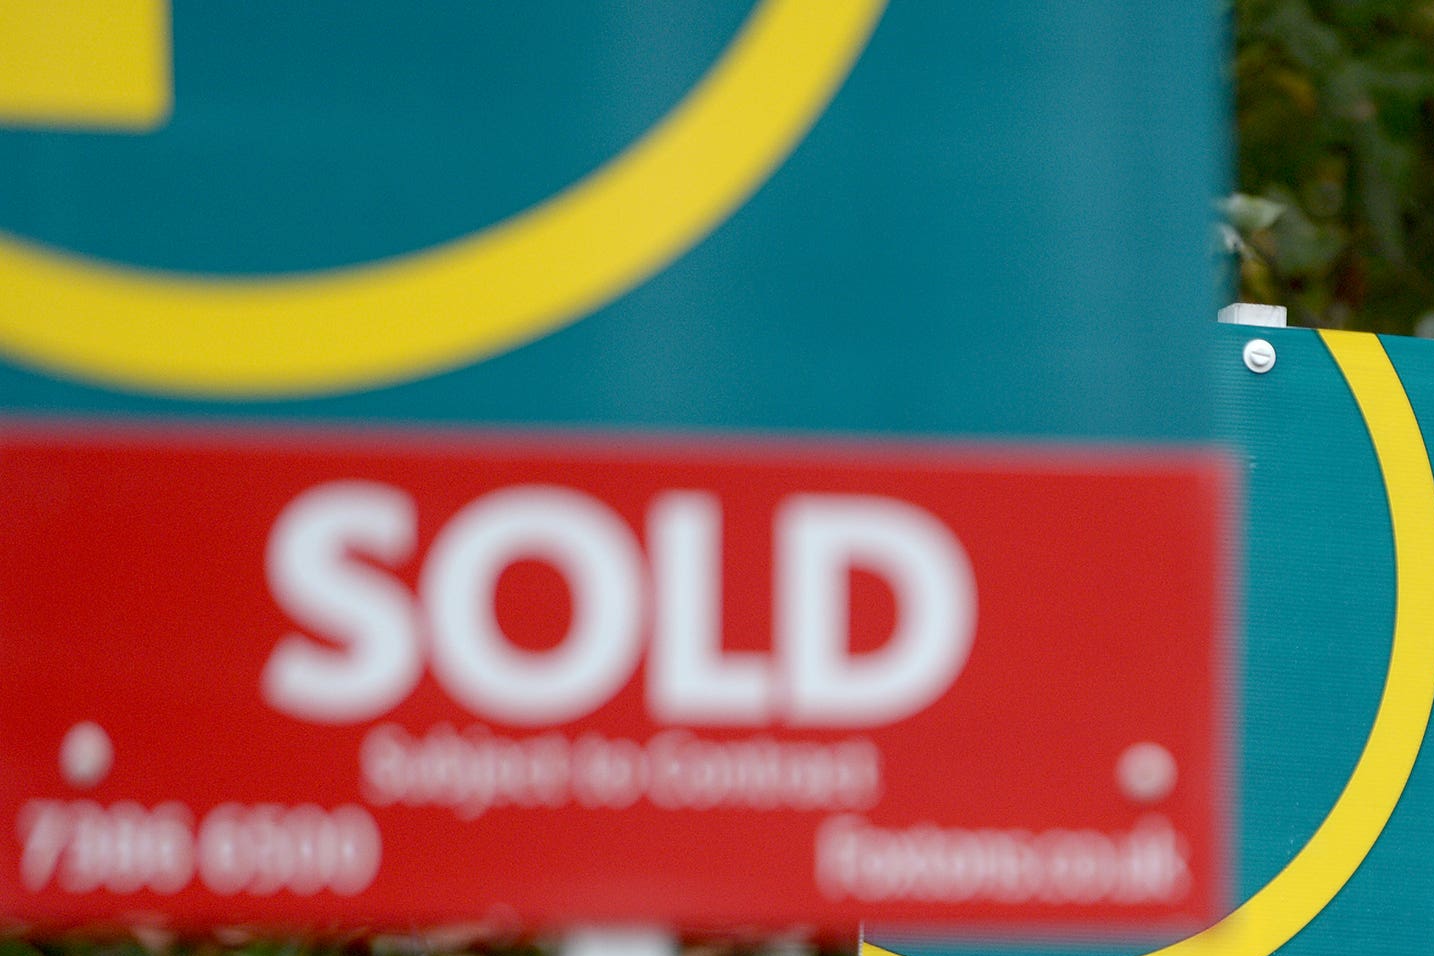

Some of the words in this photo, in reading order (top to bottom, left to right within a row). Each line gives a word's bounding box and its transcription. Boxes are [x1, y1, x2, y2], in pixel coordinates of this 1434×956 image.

[265, 480, 976, 727] SOLD
[362, 724, 576, 822] Subject
[648, 729, 880, 811] Contract
